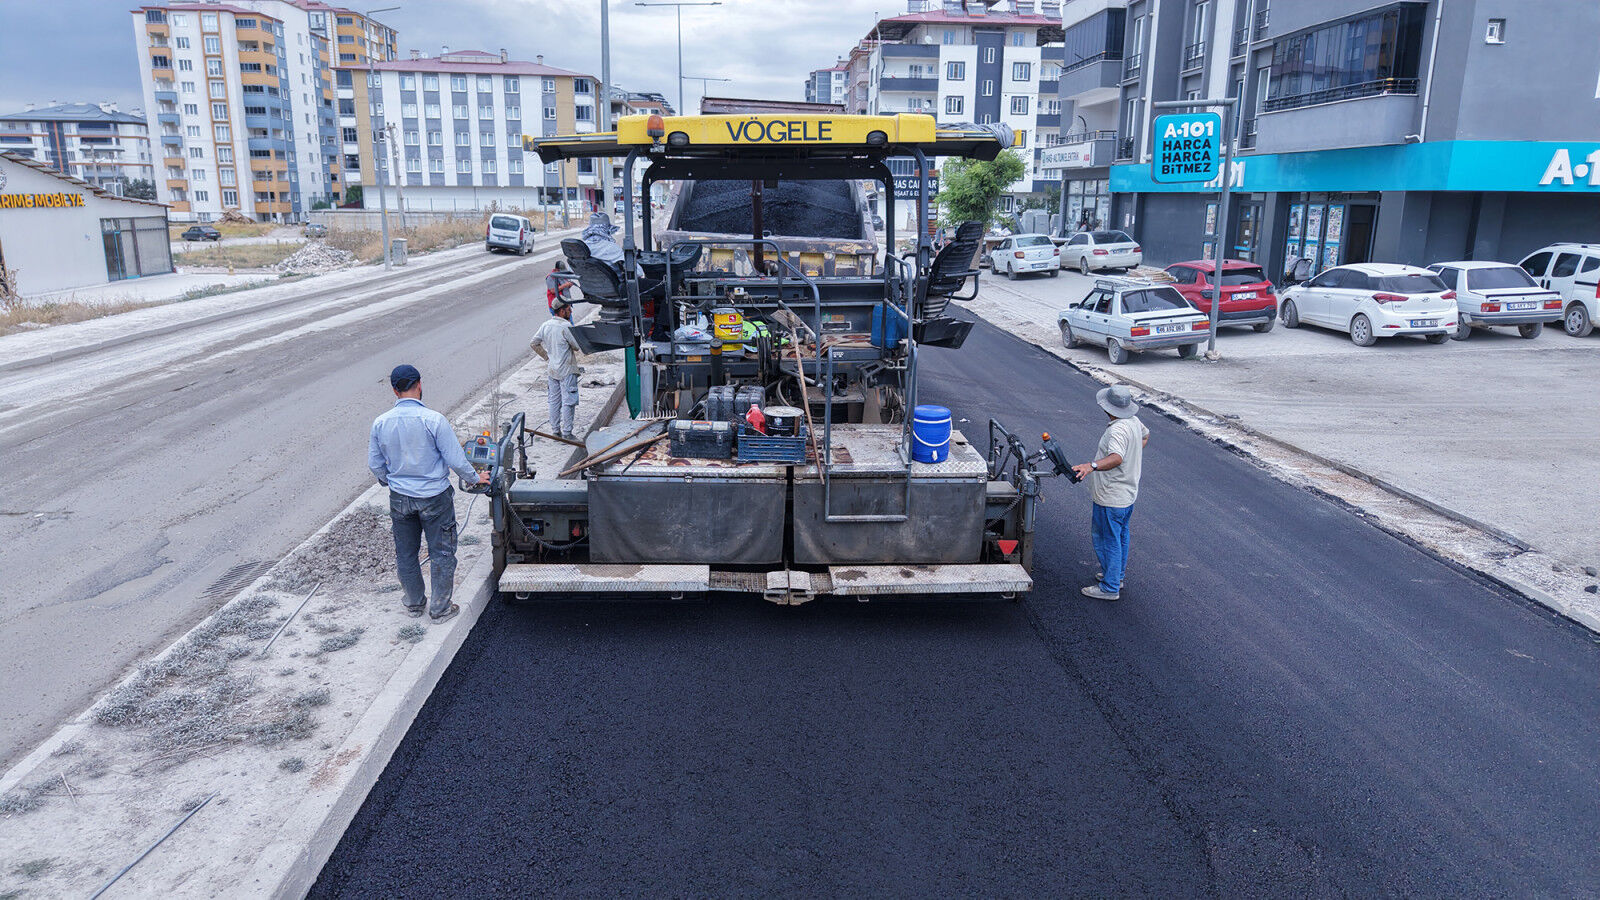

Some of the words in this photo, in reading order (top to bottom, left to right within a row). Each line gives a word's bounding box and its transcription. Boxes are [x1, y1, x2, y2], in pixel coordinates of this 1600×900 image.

[725, 116, 832, 142] VÖGELE
[1162, 138, 1212, 151] HARCA
[1162, 150, 1211, 163] HARCA
